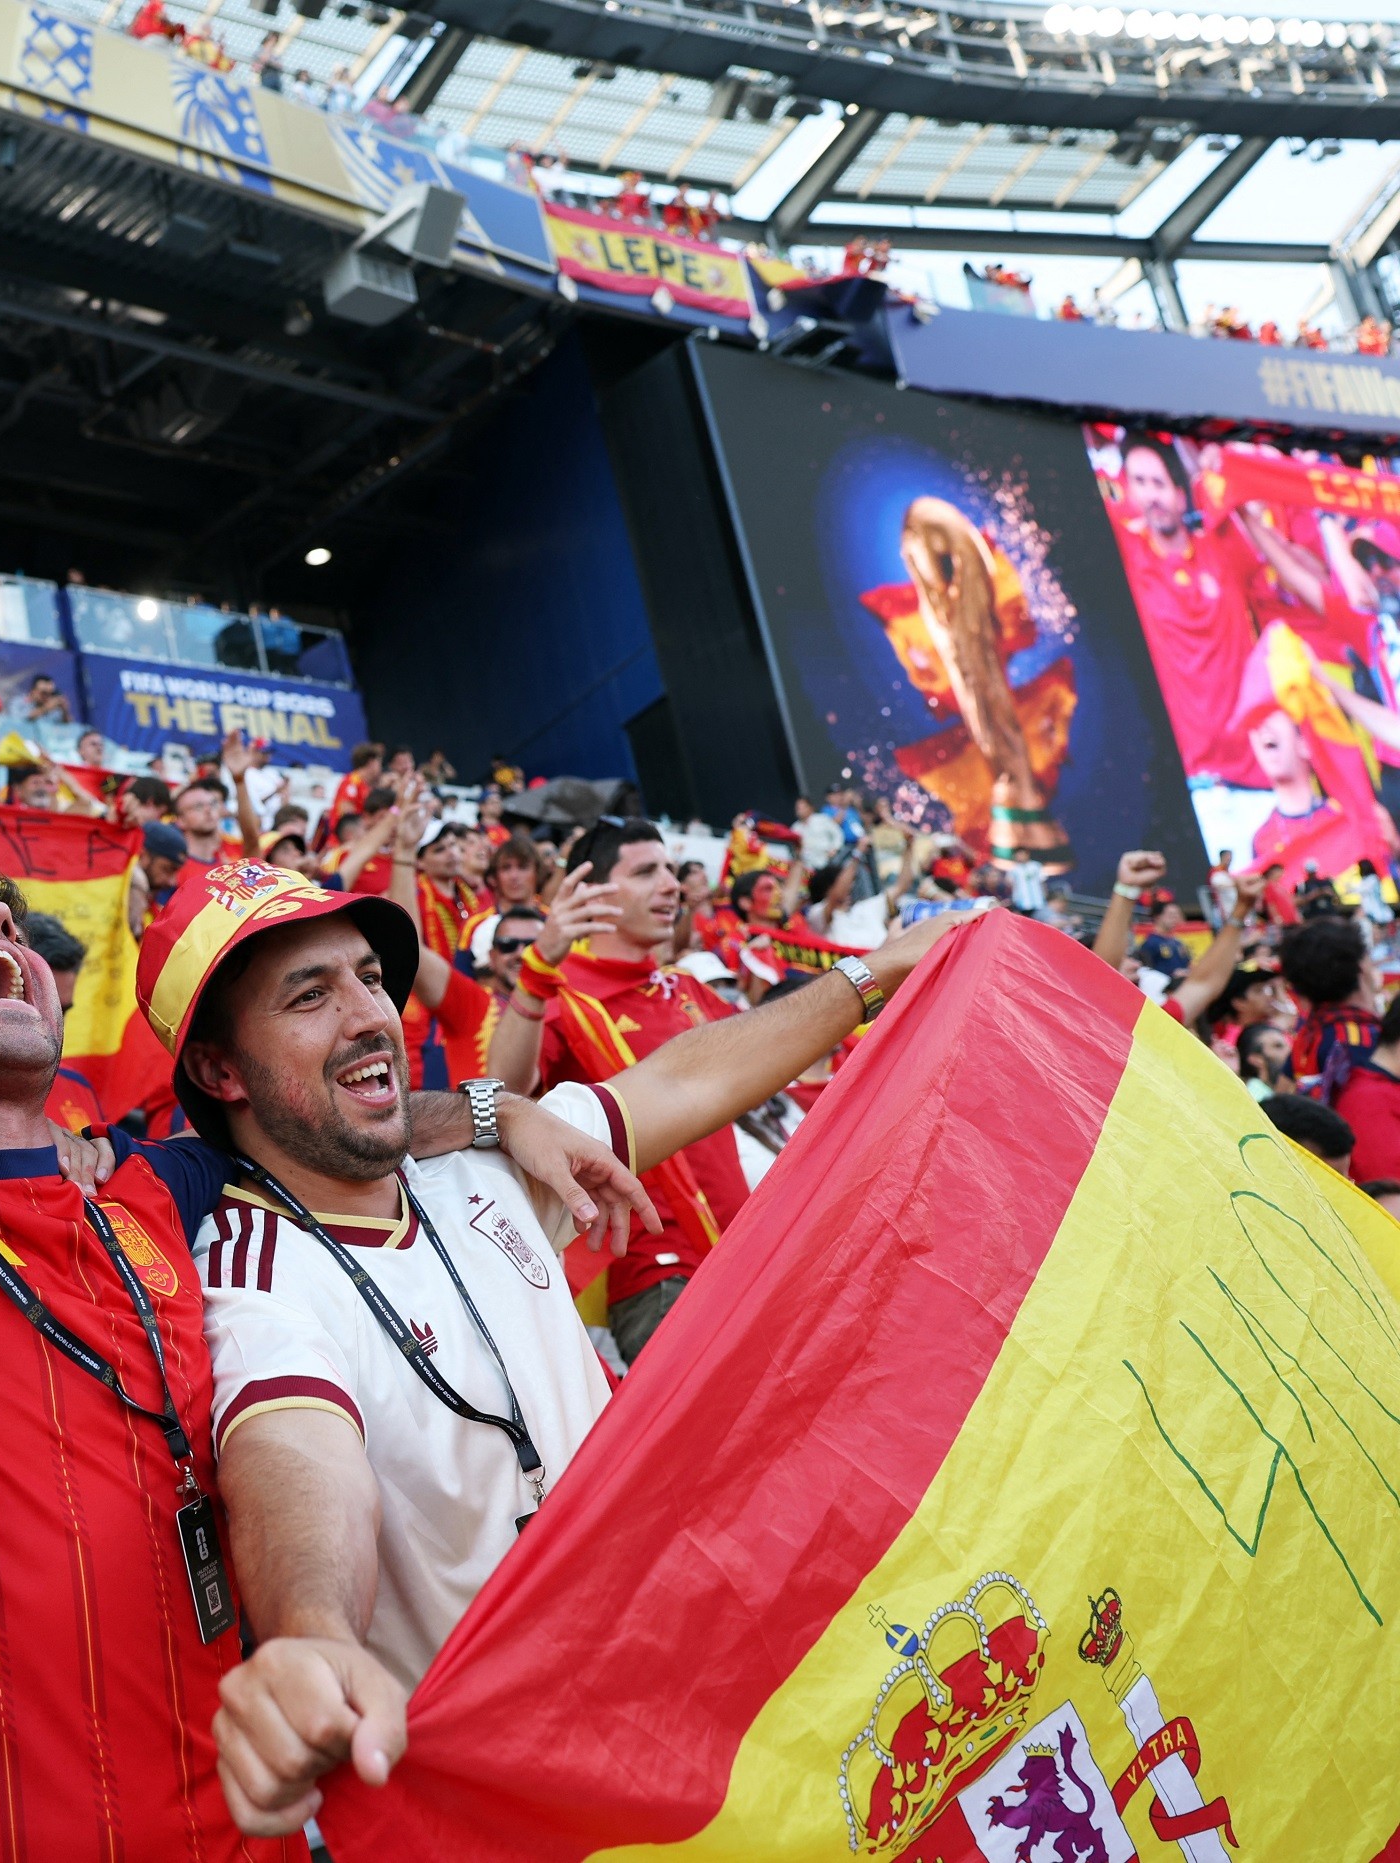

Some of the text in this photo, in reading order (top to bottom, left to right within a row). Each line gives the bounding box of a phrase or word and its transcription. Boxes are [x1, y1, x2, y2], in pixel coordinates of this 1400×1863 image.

[599, 233, 703, 288] LEPE
[119, 669, 336, 719] FIFA WORLD CUP 2026
[125, 692, 342, 749] THE FINAL
[93, 1210, 105, 1227] WORLD
[265, 1178, 303, 1215] FIFA WORLD CUP 2026
[101, 1226, 110, 1237] FIFA
[315, 1227, 355, 1270] FIFA WORLD CUP 2026
[4, 1276, 15, 1287] CUP
[11, 1285, 28, 1304] 2026
[116, 1255, 147, 1310] FIFA WORLD CUP 2026
[365, 1285, 404, 1337] FIFA WORLD CUP 2026
[43, 1322, 99, 1370] FIFA WORLD CUP 2026
[414, 1355, 458, 1405] FIFA WORLD CUP 2026
[1126, 1723, 1188, 1786] VLTRA
